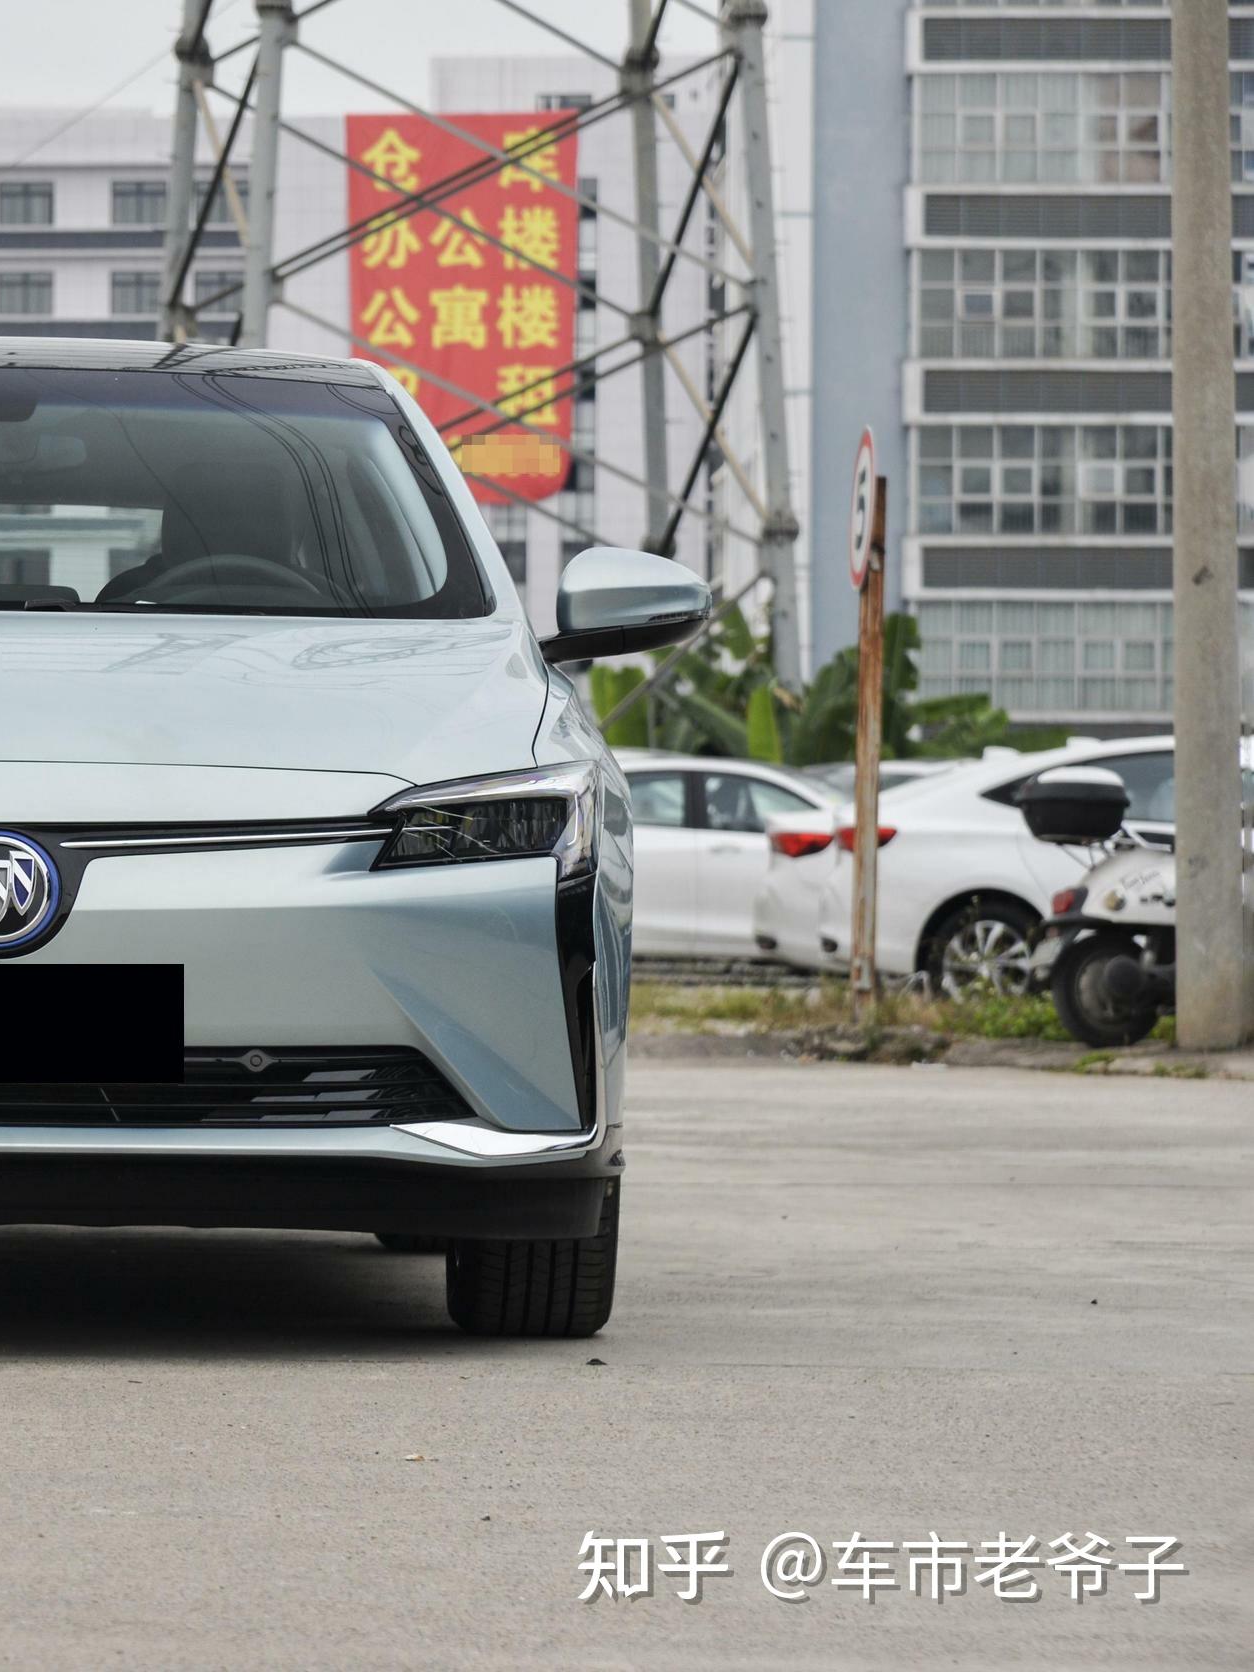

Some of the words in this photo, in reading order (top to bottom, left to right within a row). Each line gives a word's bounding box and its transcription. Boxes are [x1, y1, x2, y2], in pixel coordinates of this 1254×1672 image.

[361, 127, 559, 193] 仓库
[360, 205, 560, 270] 办公楼
[360, 284, 559, 350] 公寓楼
[856, 468, 867, 551] 5
